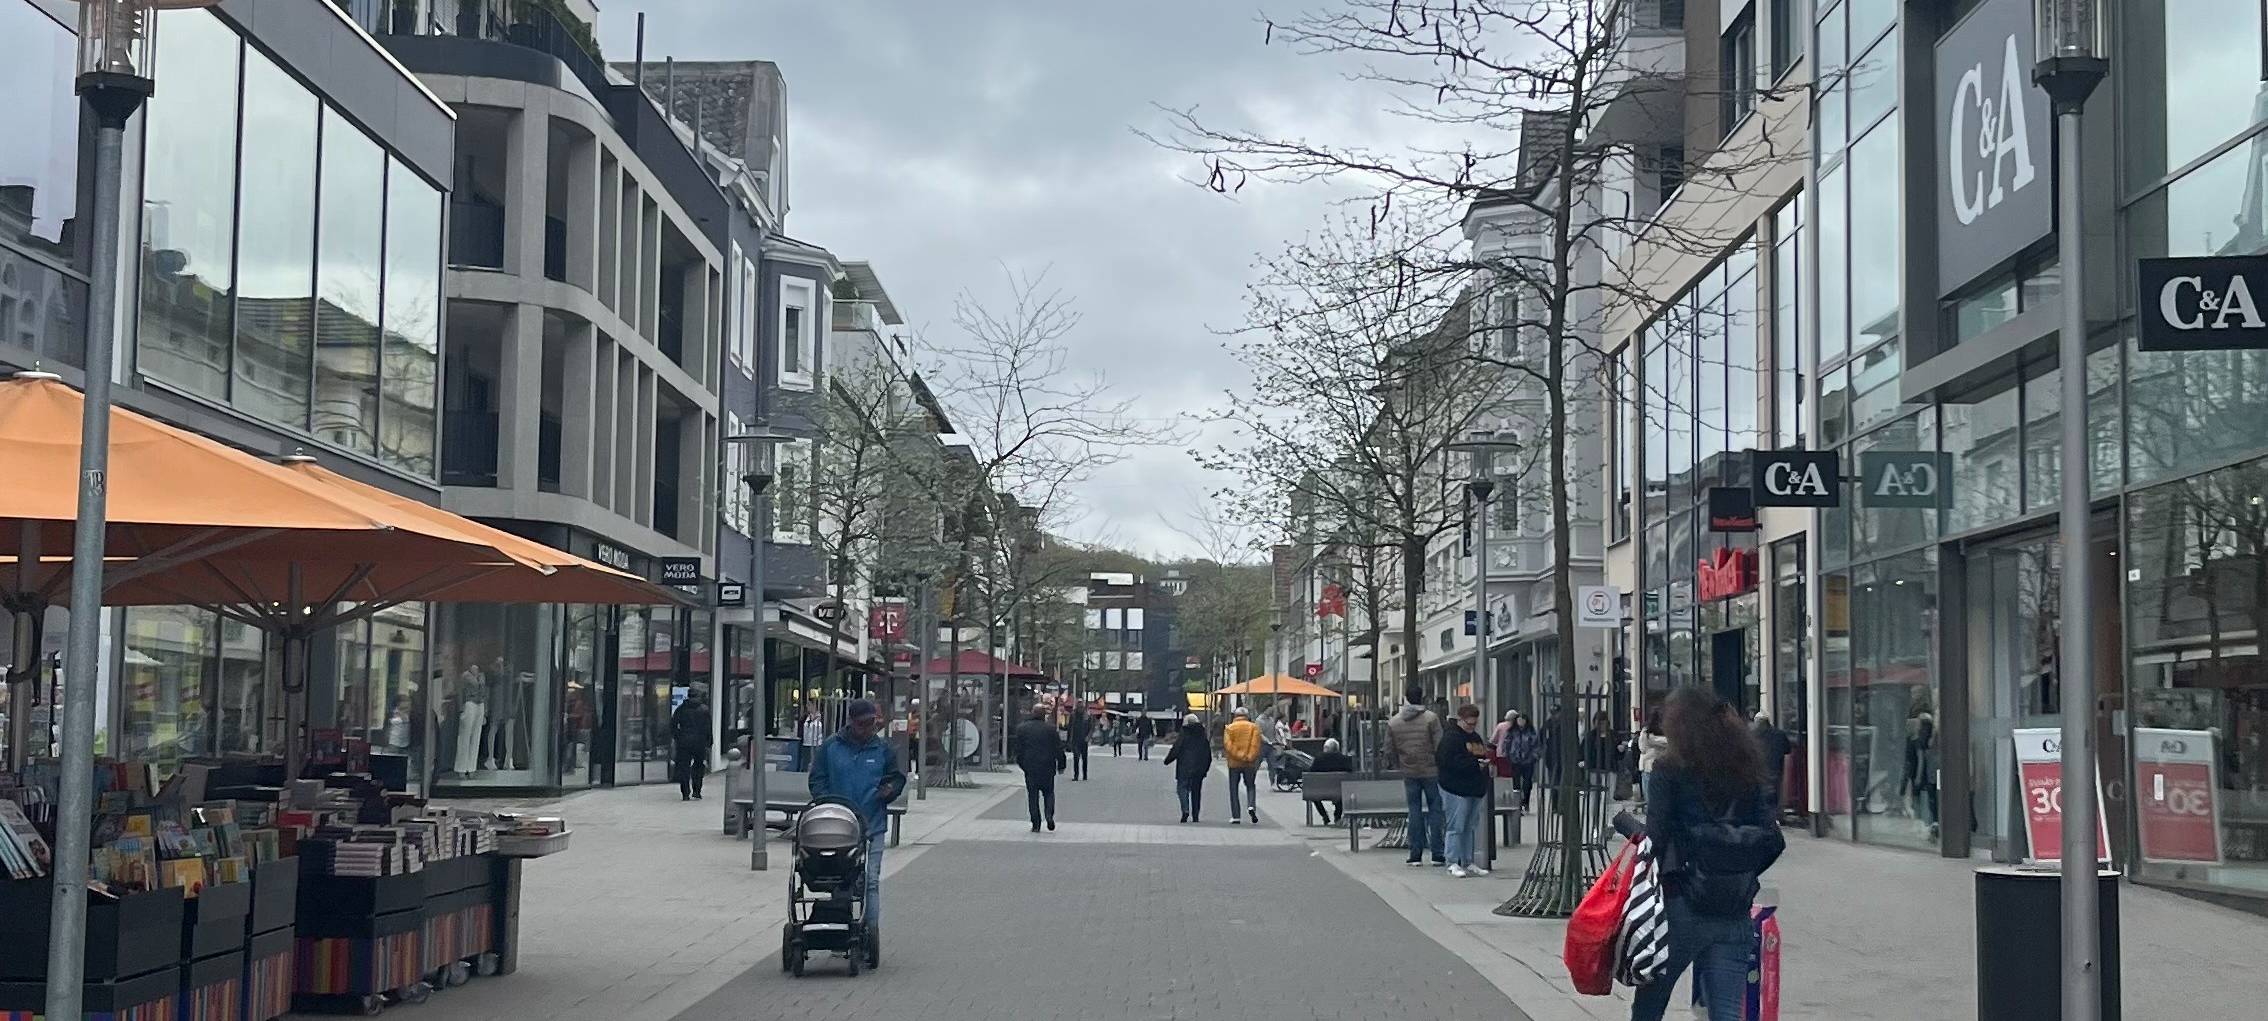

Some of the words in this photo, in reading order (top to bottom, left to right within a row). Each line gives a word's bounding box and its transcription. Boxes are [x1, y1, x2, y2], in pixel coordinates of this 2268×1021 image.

[1950, 34, 2035, 226] C&A
[2160, 275, 2266, 331] C&A
[1764, 462, 1829, 496] C&A
[663, 571, 697, 579] MODA
[665, 563, 695, 571] VERO
